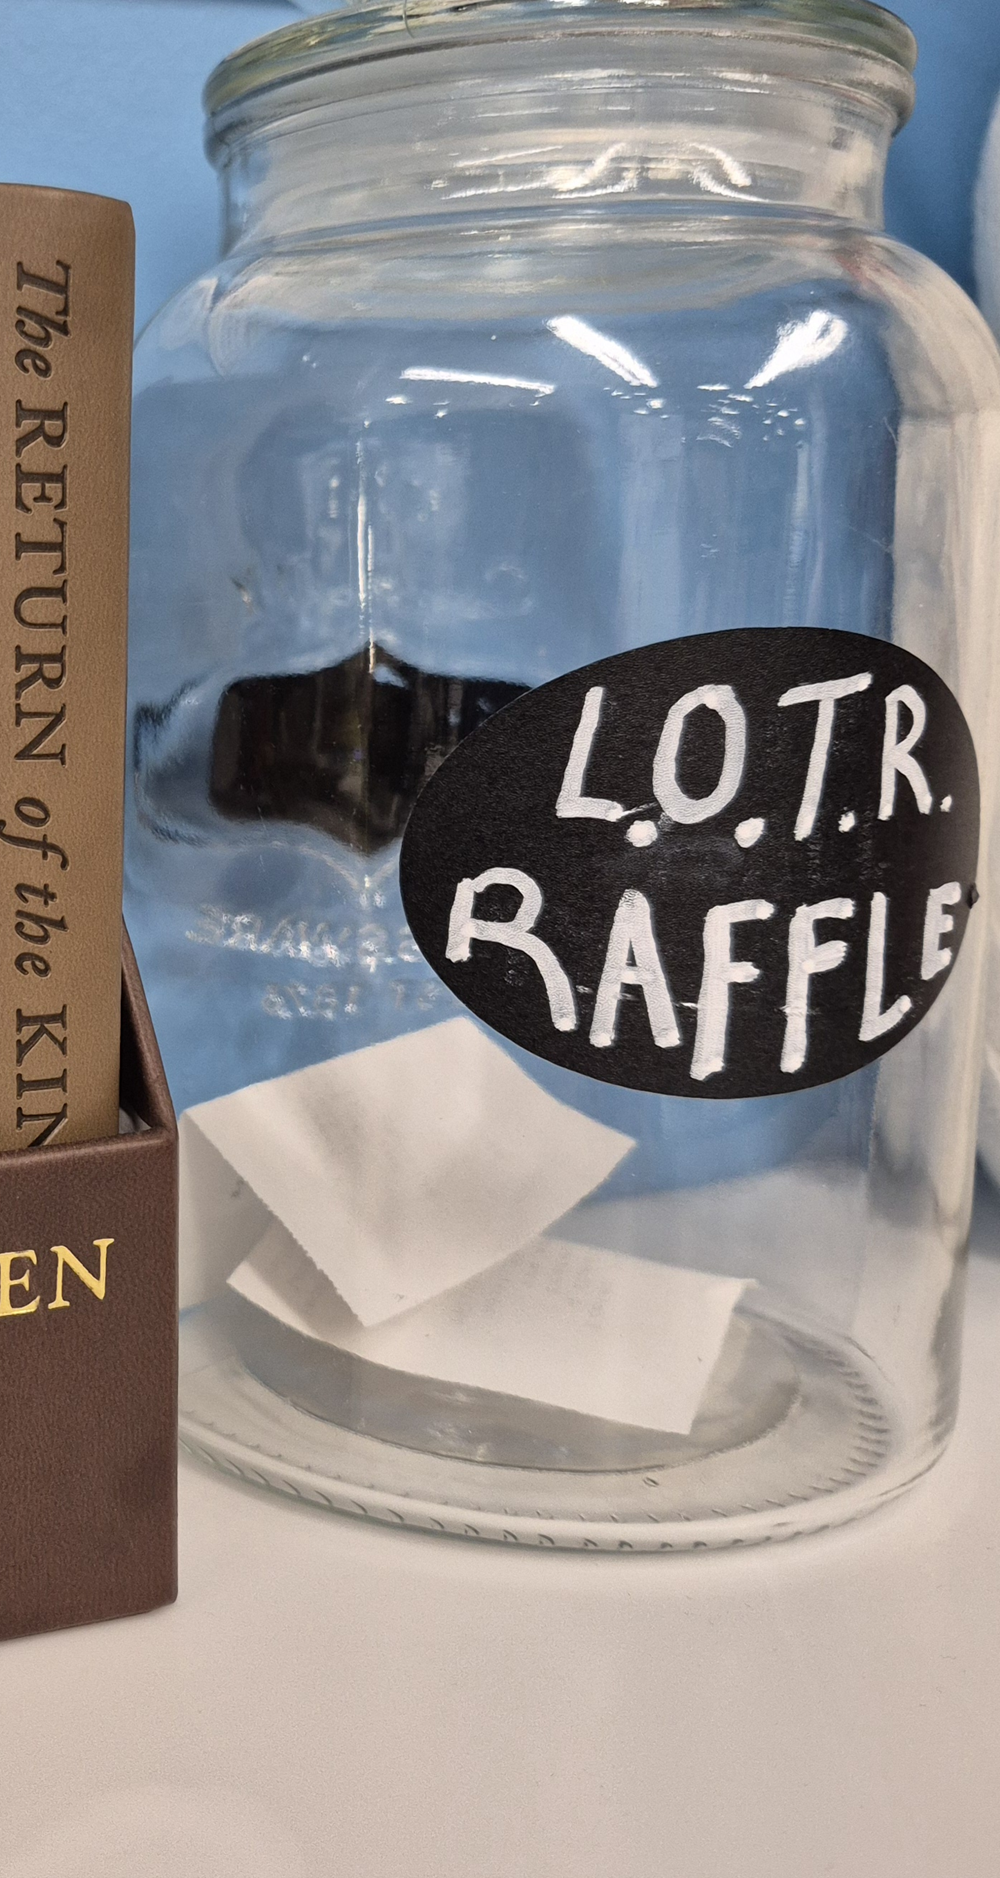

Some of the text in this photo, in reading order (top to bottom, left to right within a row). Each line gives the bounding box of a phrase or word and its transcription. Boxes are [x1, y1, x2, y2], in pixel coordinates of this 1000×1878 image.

[14, 259, 73, 379] The
[12, 398, 69, 768] RETURN
[555, 671, 953, 848] L.O.T.R.
[13, 881, 69, 978] the
[445, 866, 961, 1081] RAFFLE
